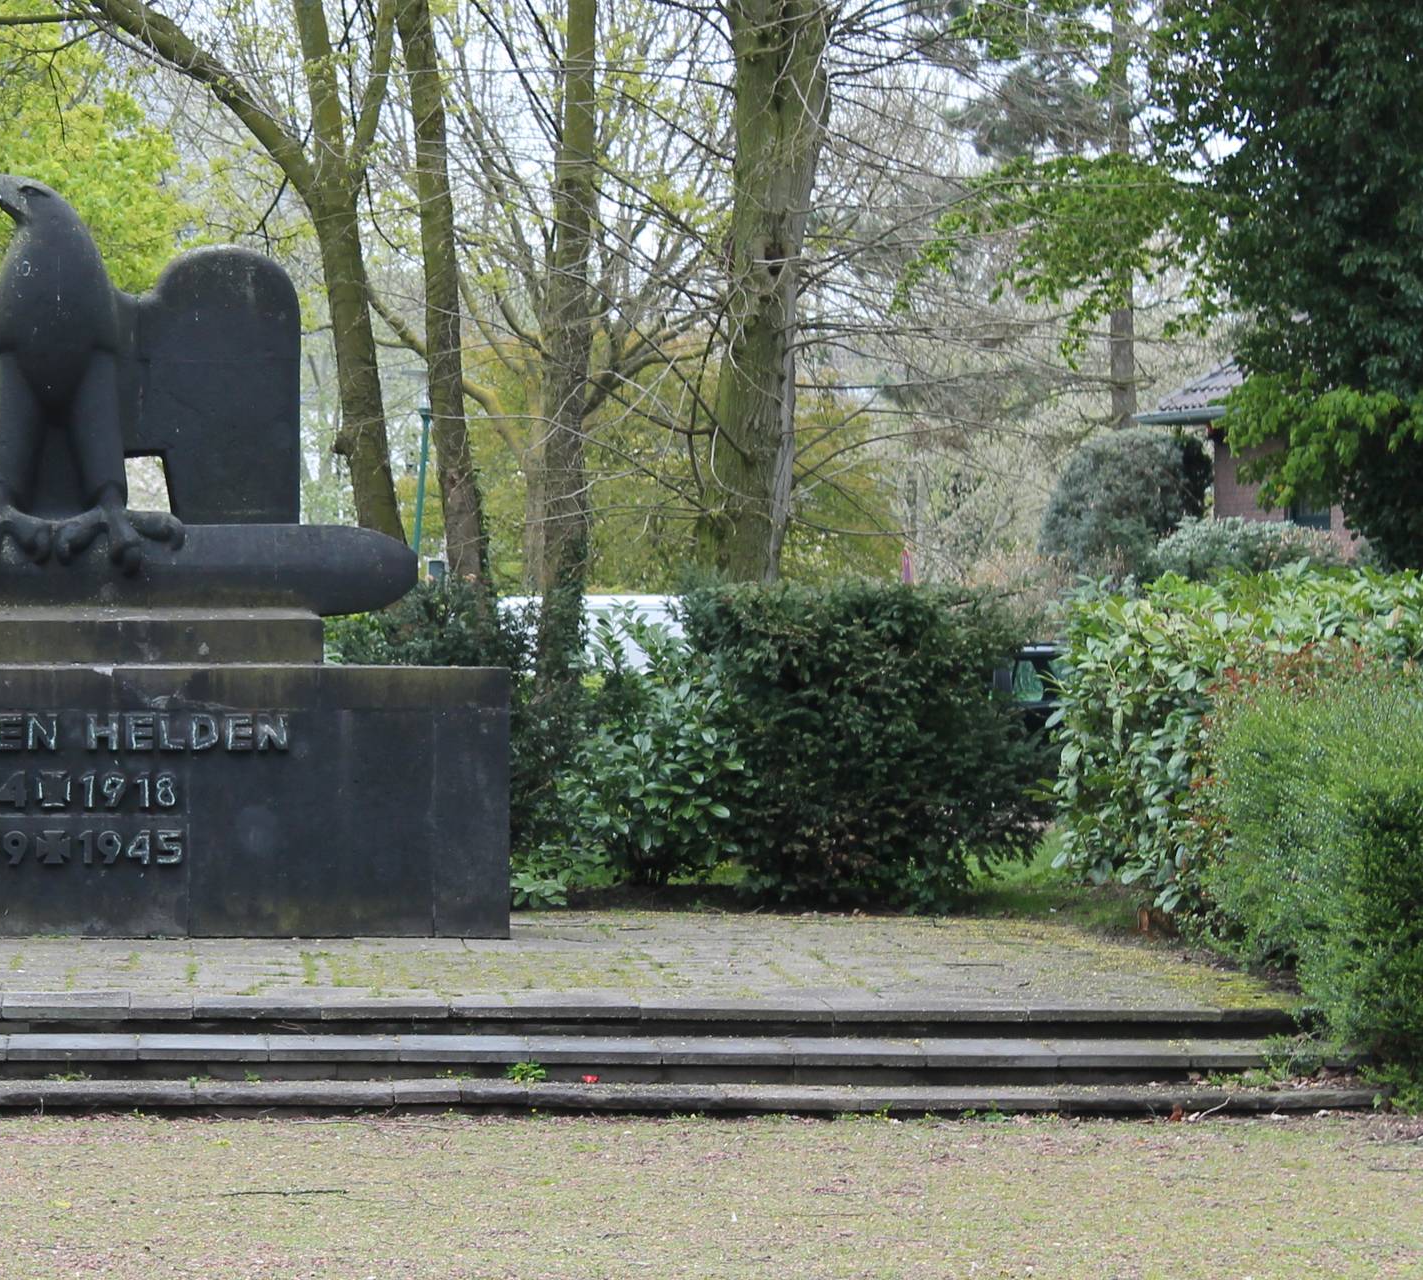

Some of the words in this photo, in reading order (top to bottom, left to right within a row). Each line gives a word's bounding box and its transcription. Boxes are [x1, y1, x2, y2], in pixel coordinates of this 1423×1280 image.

[85, 712, 290, 751] HELDEN
[79, 769, 179, 809] 1918
[78, 828, 184, 866] 1945
